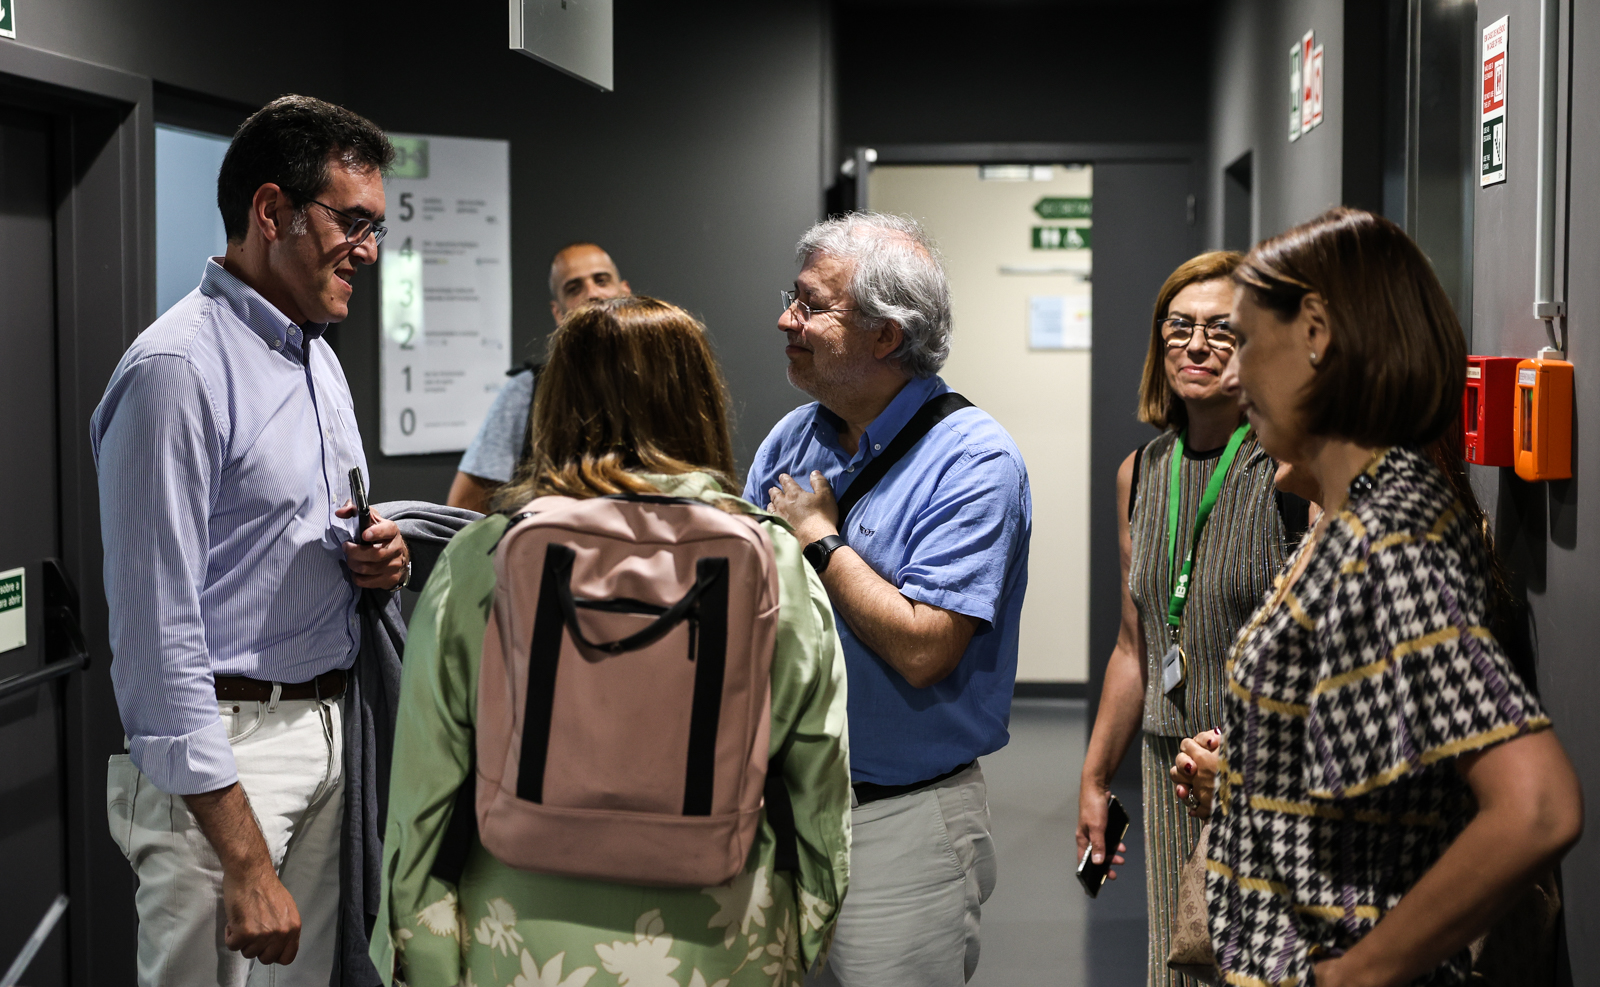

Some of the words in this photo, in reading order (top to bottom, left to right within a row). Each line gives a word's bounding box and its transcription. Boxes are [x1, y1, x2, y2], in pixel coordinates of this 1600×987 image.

[399, 192, 414, 222] 5
[400, 237, 413, 262] 4
[400, 279, 414, 308] 3
[400, 323, 414, 350] 2
[402, 366, 412, 393] 1
[400, 408, 416, 436] 0
